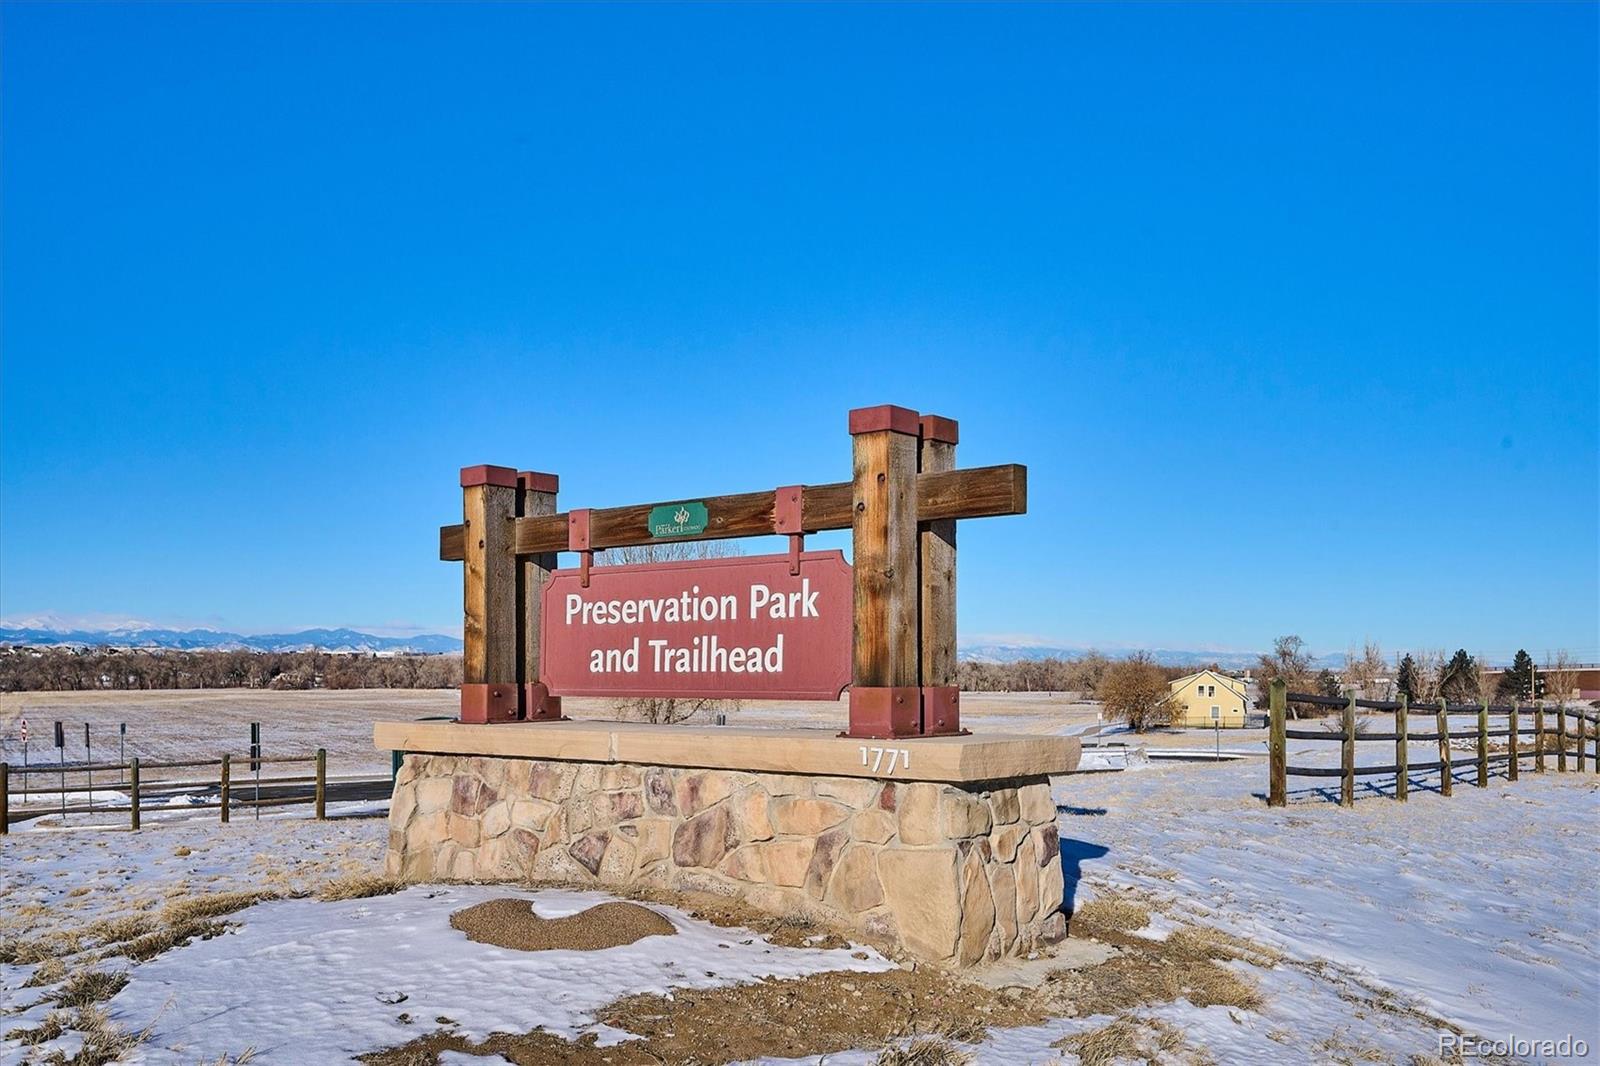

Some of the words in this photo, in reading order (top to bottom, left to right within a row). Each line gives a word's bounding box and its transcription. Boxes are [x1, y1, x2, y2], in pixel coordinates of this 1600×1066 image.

[566, 585, 737, 625] Preservation
[750, 578, 819, 619] Park
[589, 637, 639, 673] and
[648, 634, 784, 673] Trailhead
[859, 746, 909, 774] 1771
